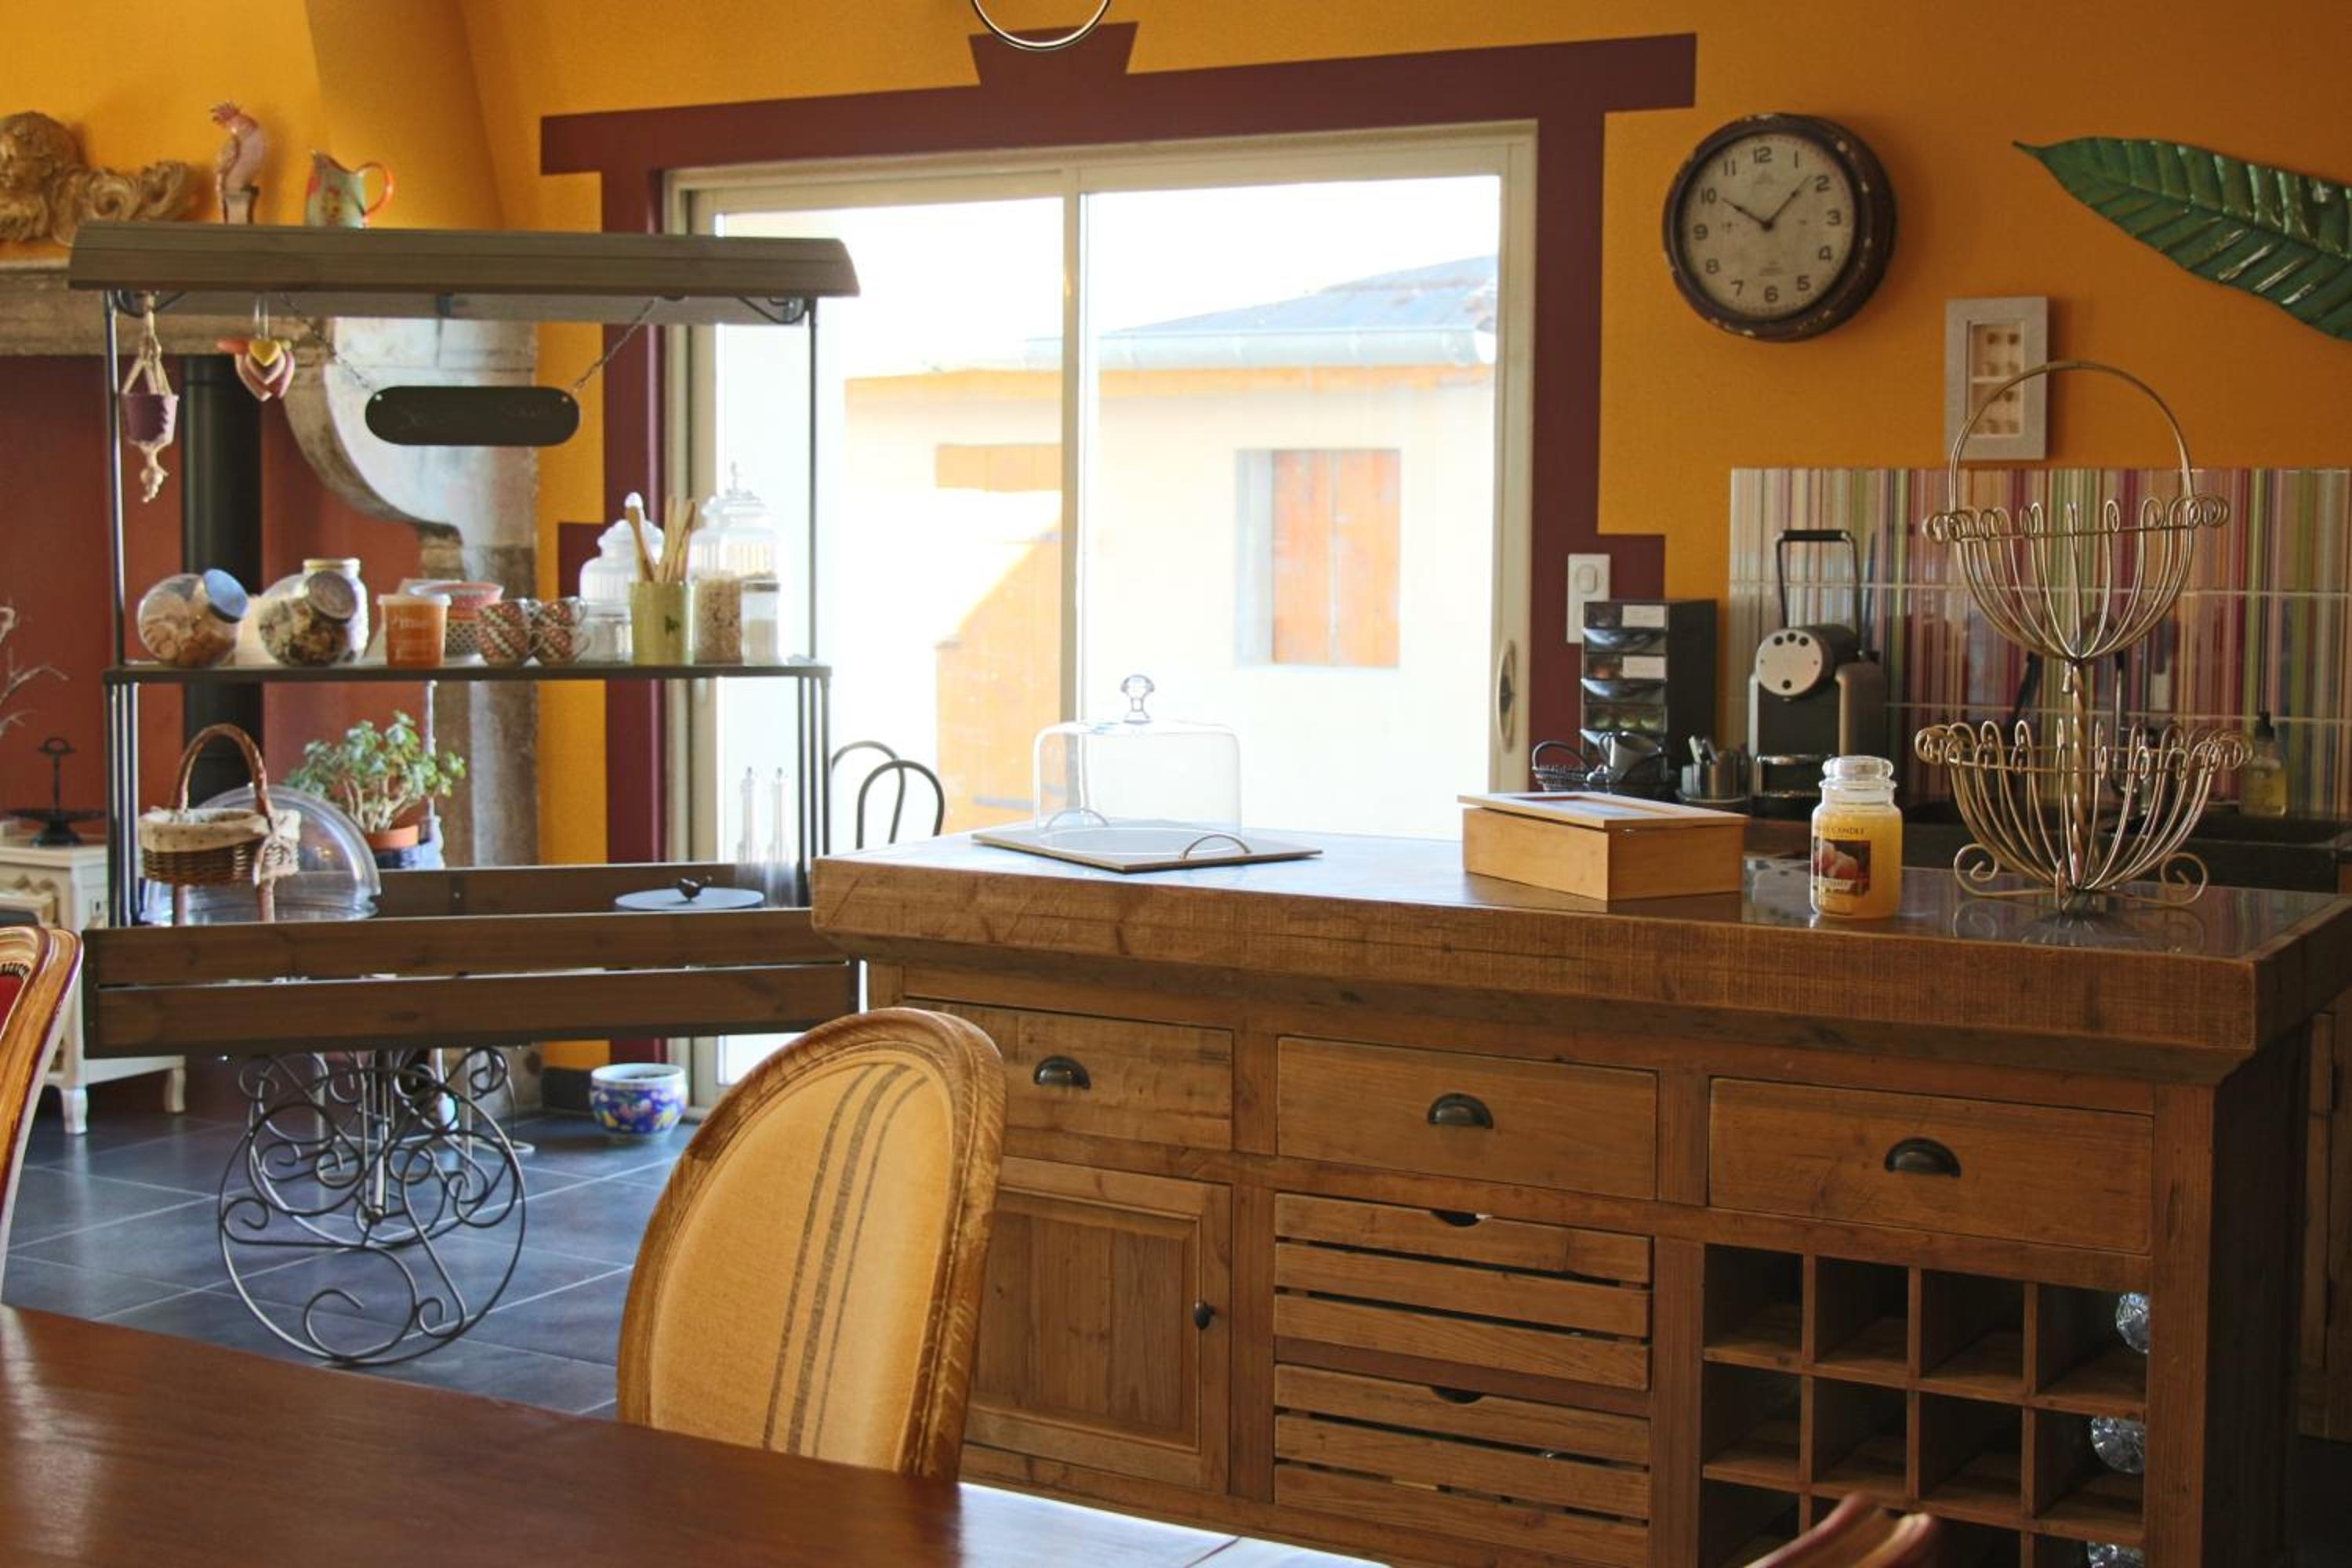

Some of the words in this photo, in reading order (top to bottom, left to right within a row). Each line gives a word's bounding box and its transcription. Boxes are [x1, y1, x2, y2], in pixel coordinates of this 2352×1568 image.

[1753, 147, 1772, 164] 12
[1724, 161, 1736, 176] 11
[1816, 176, 1831, 191] 2
[1700, 188, 1717, 204] 10
[1828, 212, 1841, 225] 3
[1693, 224, 1708, 240] 9
[1819, 246, 1832, 261] 4
[1706, 259, 1720, 274] 8
[1731, 280, 1744, 296] 7
[1797, 276, 1811, 291] 5
[1765, 287, 1779, 303] 6
